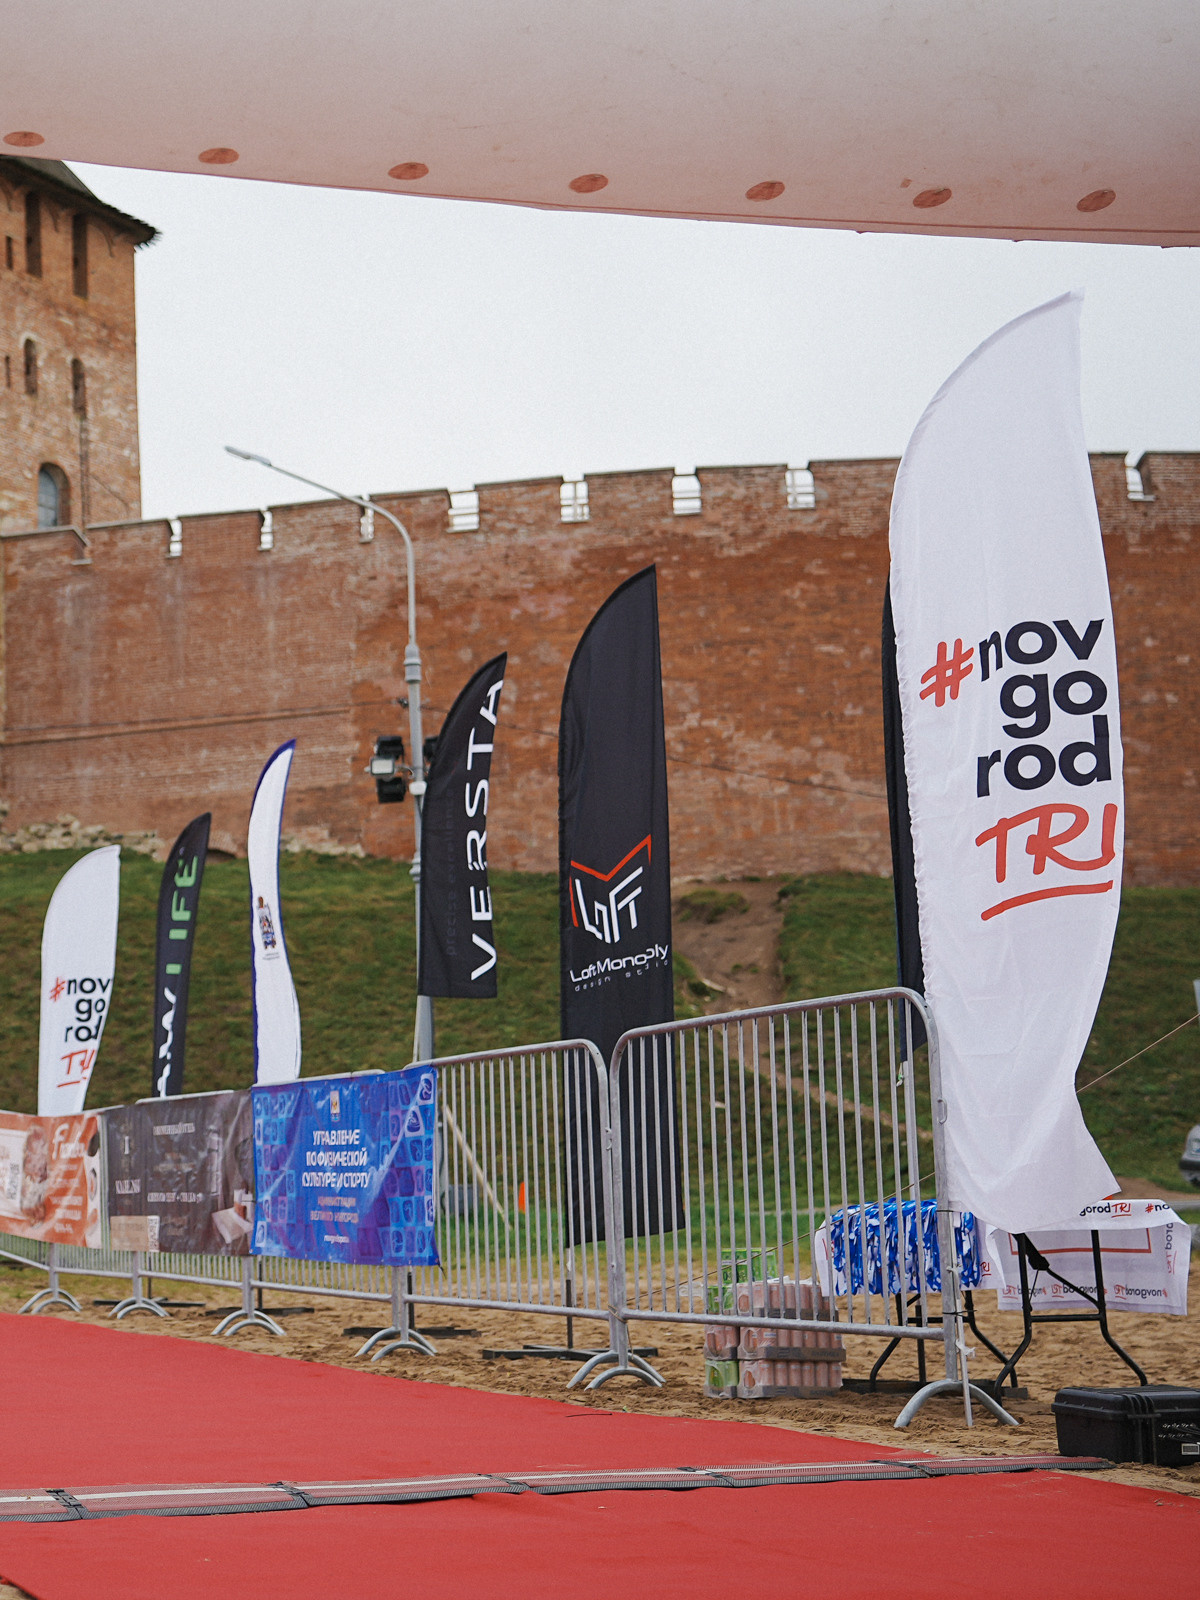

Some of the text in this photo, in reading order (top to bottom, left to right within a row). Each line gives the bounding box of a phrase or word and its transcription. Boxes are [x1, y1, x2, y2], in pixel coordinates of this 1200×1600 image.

[919, 618, 1105, 707] #nov
[999, 670, 1108, 739] go
[976, 714, 1112, 798] rod
[465, 679, 504, 981] VERSTA
[975, 803, 1118, 884] TRI
[50, 976, 111, 1003] #nov
[75, 998, 106, 1022] go
